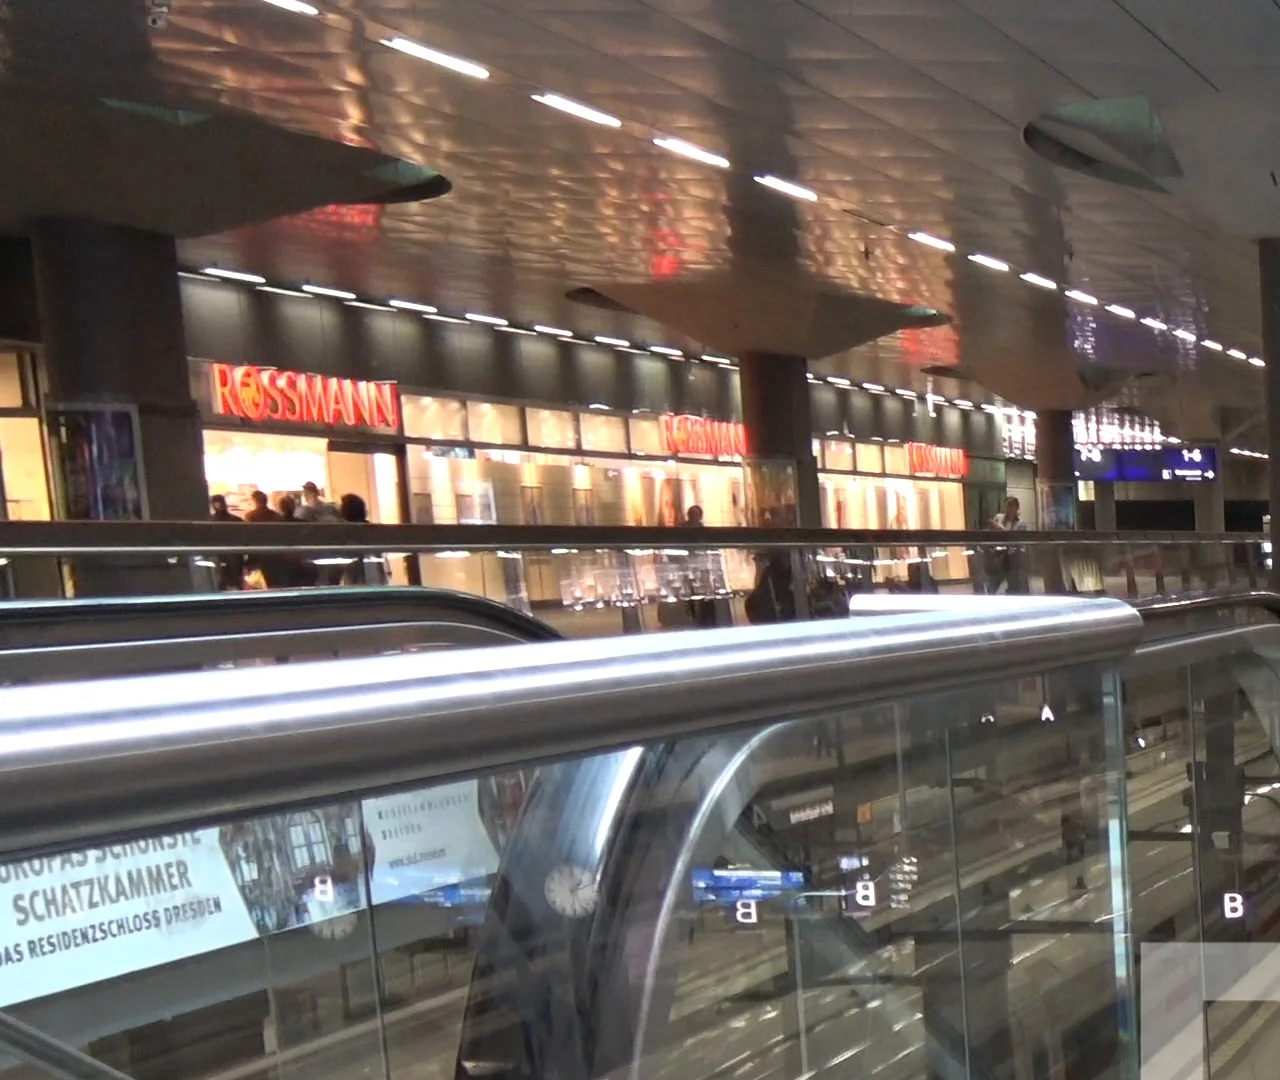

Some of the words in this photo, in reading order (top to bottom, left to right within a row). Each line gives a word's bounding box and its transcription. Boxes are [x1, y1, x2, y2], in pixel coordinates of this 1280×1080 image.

[211, 363, 398, 427] ROSSMANN
[662, 414, 746, 455] ROSSMAN
[13, 860, 192, 926] SCHATZKAMMER
[1224, 893, 1244, 918] B
[27, 909, 161, 958] RESIDENZSCHLOSS
[165, 896, 222, 925] DRESDEN
